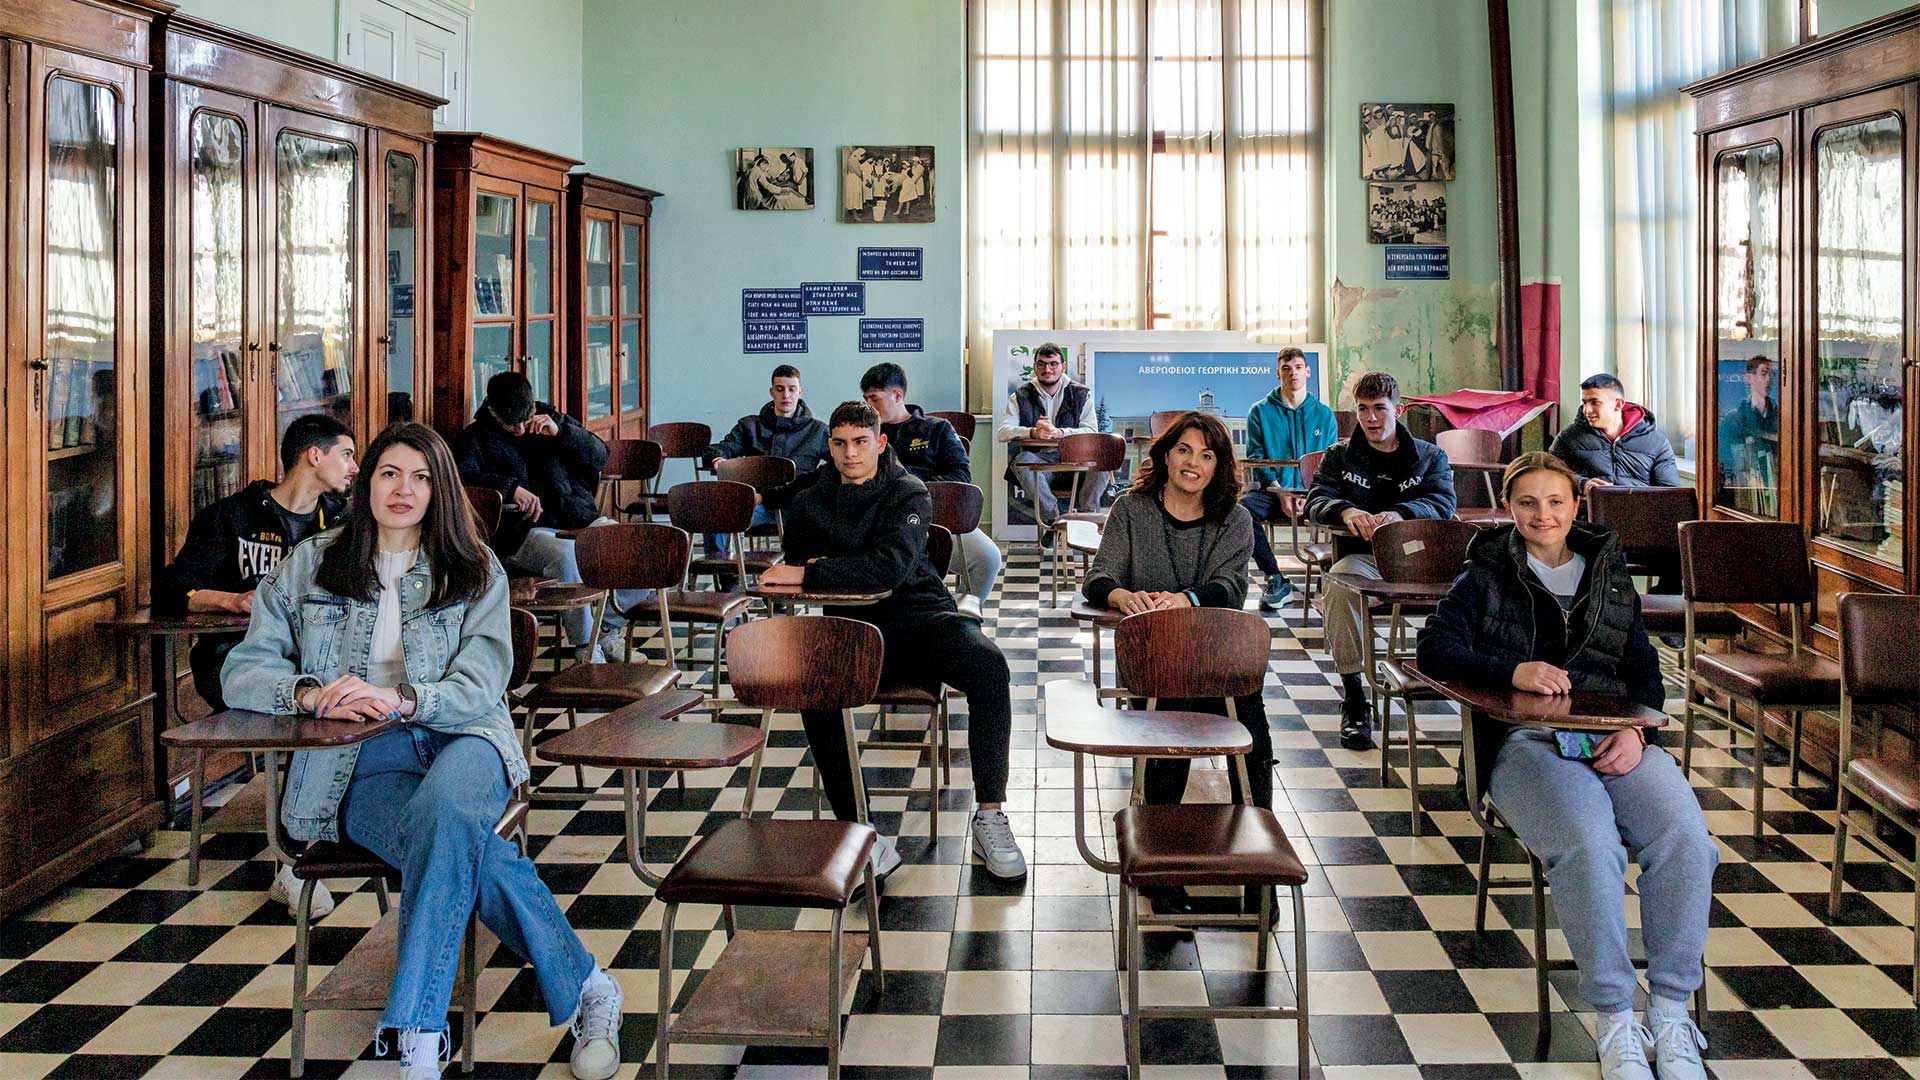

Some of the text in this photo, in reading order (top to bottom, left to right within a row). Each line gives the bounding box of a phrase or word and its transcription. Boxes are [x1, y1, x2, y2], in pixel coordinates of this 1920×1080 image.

[1138, 366, 1270, 374] ΑΒΕΡΩΦΕΙΟΣ ΓΕΩΡΓΙΚΗ ΣΧΟΛΗ
[238, 536, 282, 580] EVER
